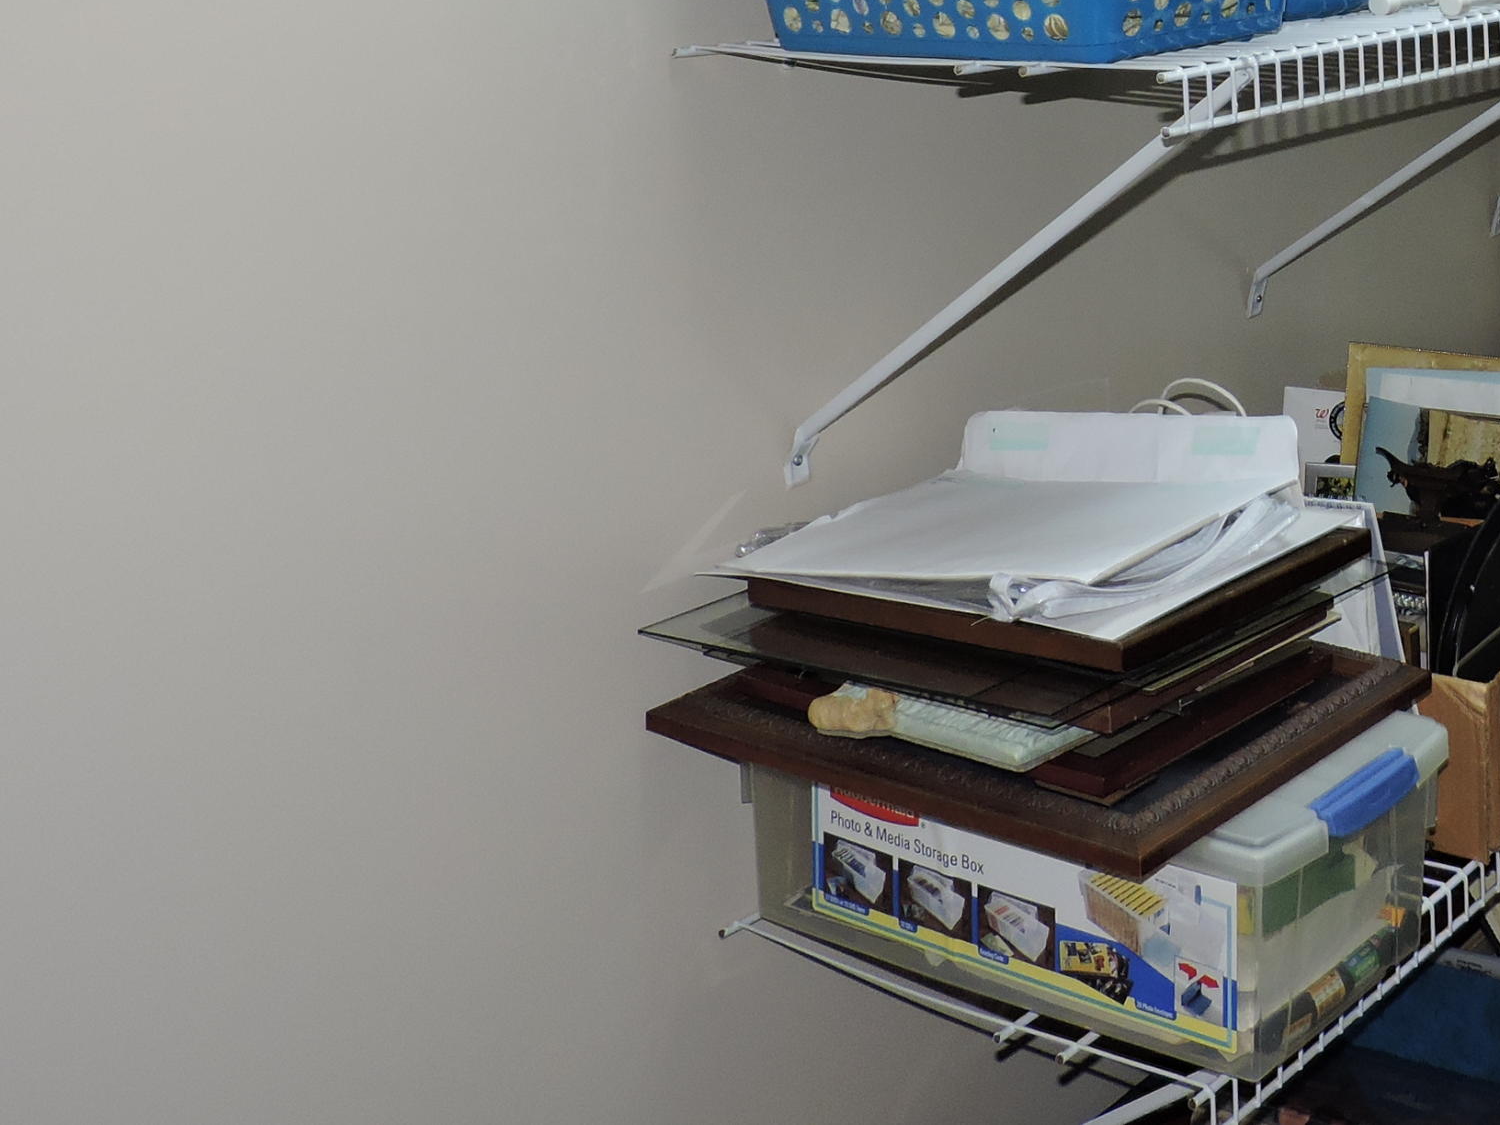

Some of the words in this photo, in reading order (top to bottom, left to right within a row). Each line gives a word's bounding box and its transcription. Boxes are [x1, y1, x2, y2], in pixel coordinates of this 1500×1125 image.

[830, 810, 861, 833] Photo
[864, 821, 873, 837] &
[876, 826, 910, 850] Media
[914, 839, 957, 868] Storage
[961, 854, 984, 875] Box
